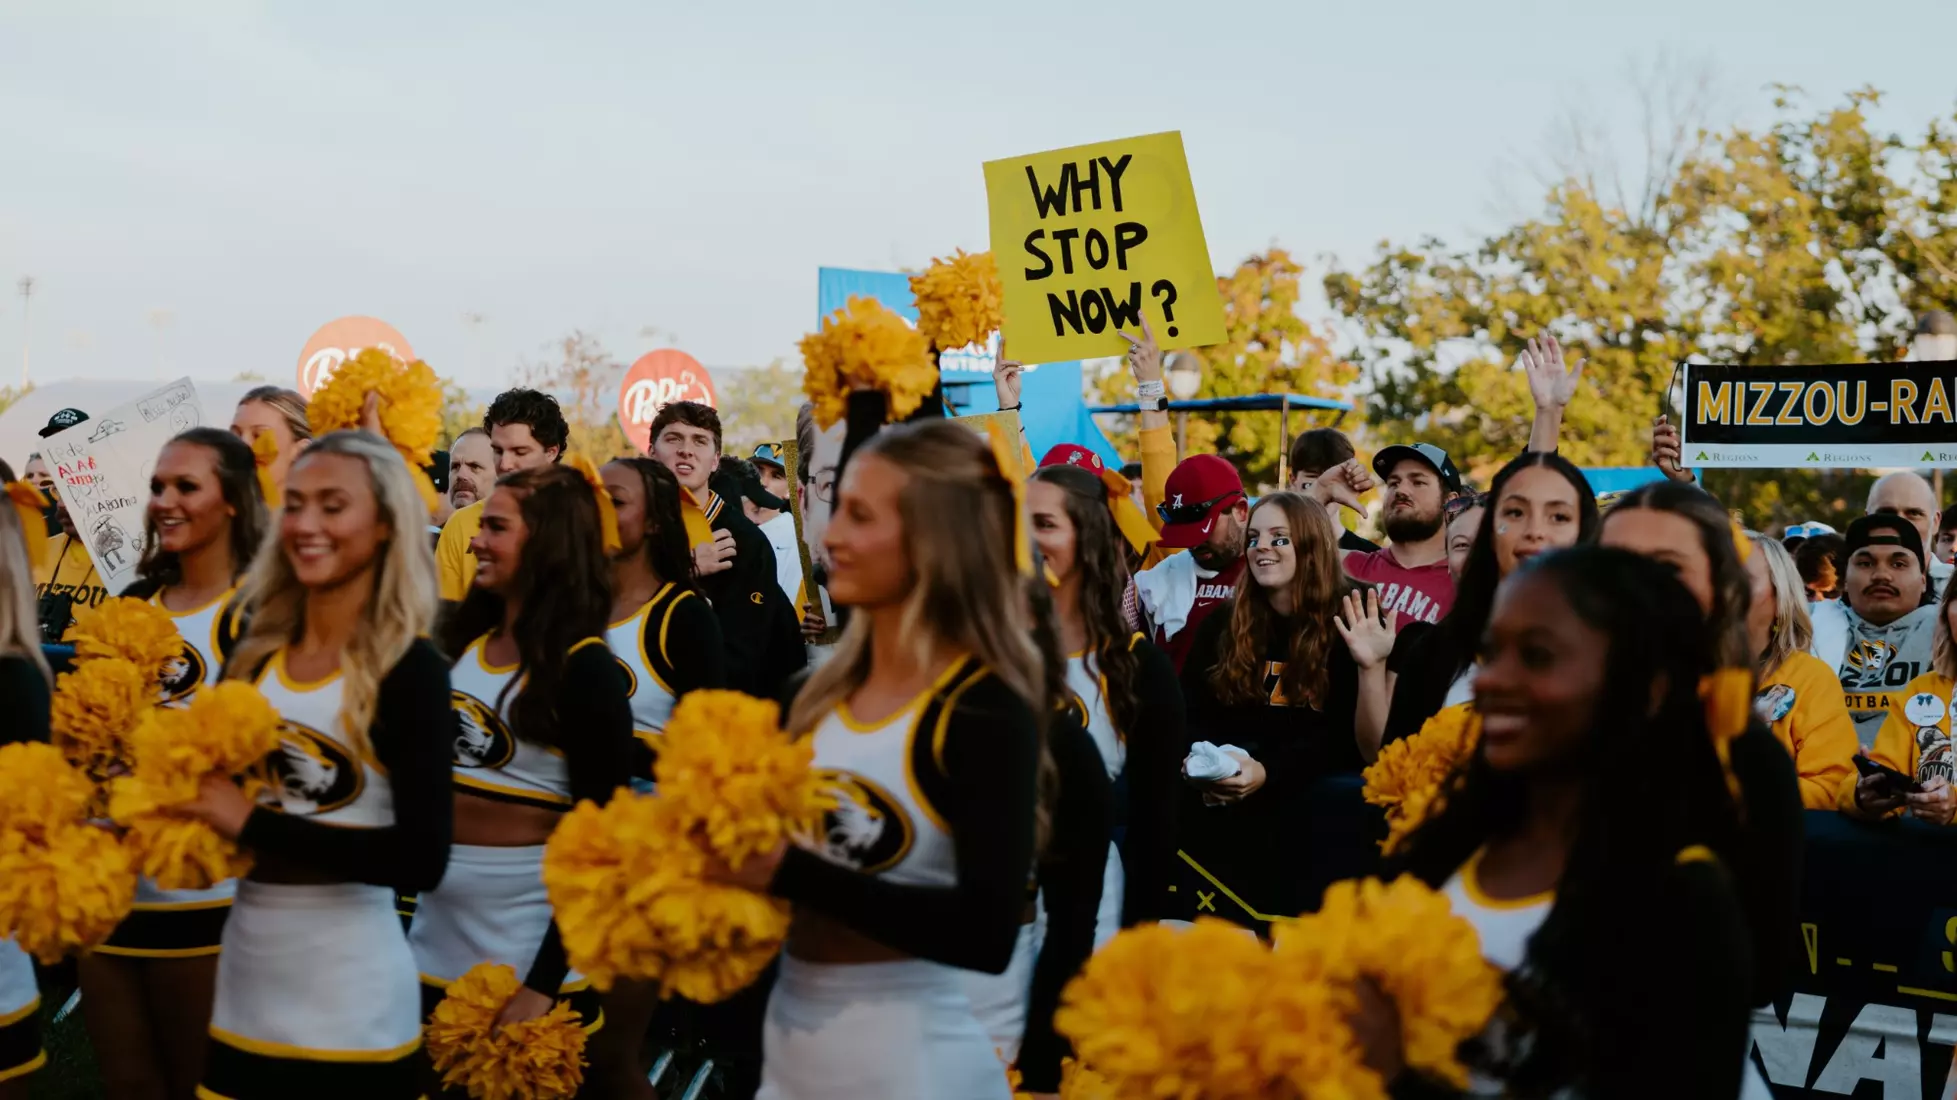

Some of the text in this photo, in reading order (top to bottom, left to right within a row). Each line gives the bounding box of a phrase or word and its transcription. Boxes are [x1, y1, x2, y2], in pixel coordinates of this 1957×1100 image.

[1025, 154, 1133, 219] WHY
[1023, 222, 1148, 281] STOP
[1047, 279, 1179, 338] NOW?
[1697, 377, 1957, 425] MIZZOU-RA
[1195, 583, 1235, 599] ABAM
